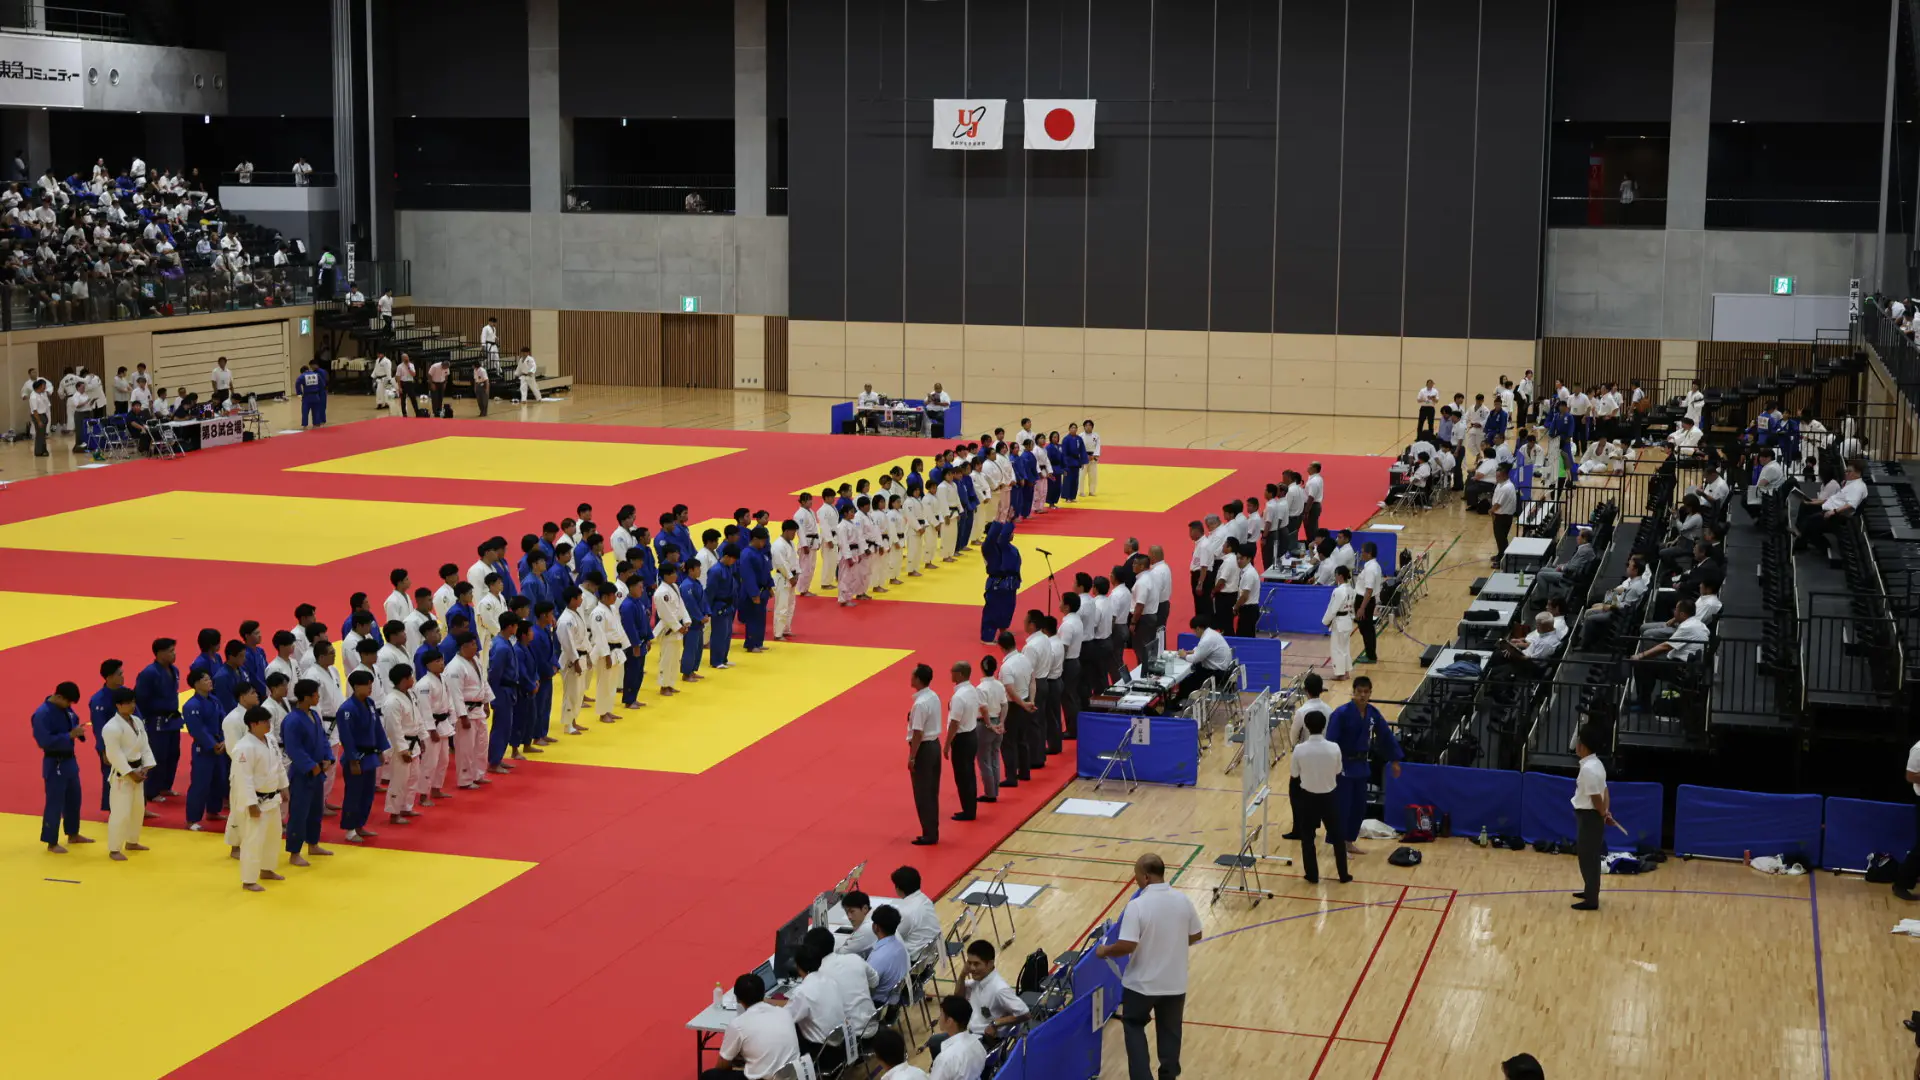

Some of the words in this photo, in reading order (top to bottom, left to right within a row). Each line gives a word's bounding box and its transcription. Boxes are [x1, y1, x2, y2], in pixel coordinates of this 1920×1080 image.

[0, 60, 79, 81] 東急コミュニティー
[1850, 280, 1859, 321] 選手入口
[202, 419, 242, 440] 第8試合場
